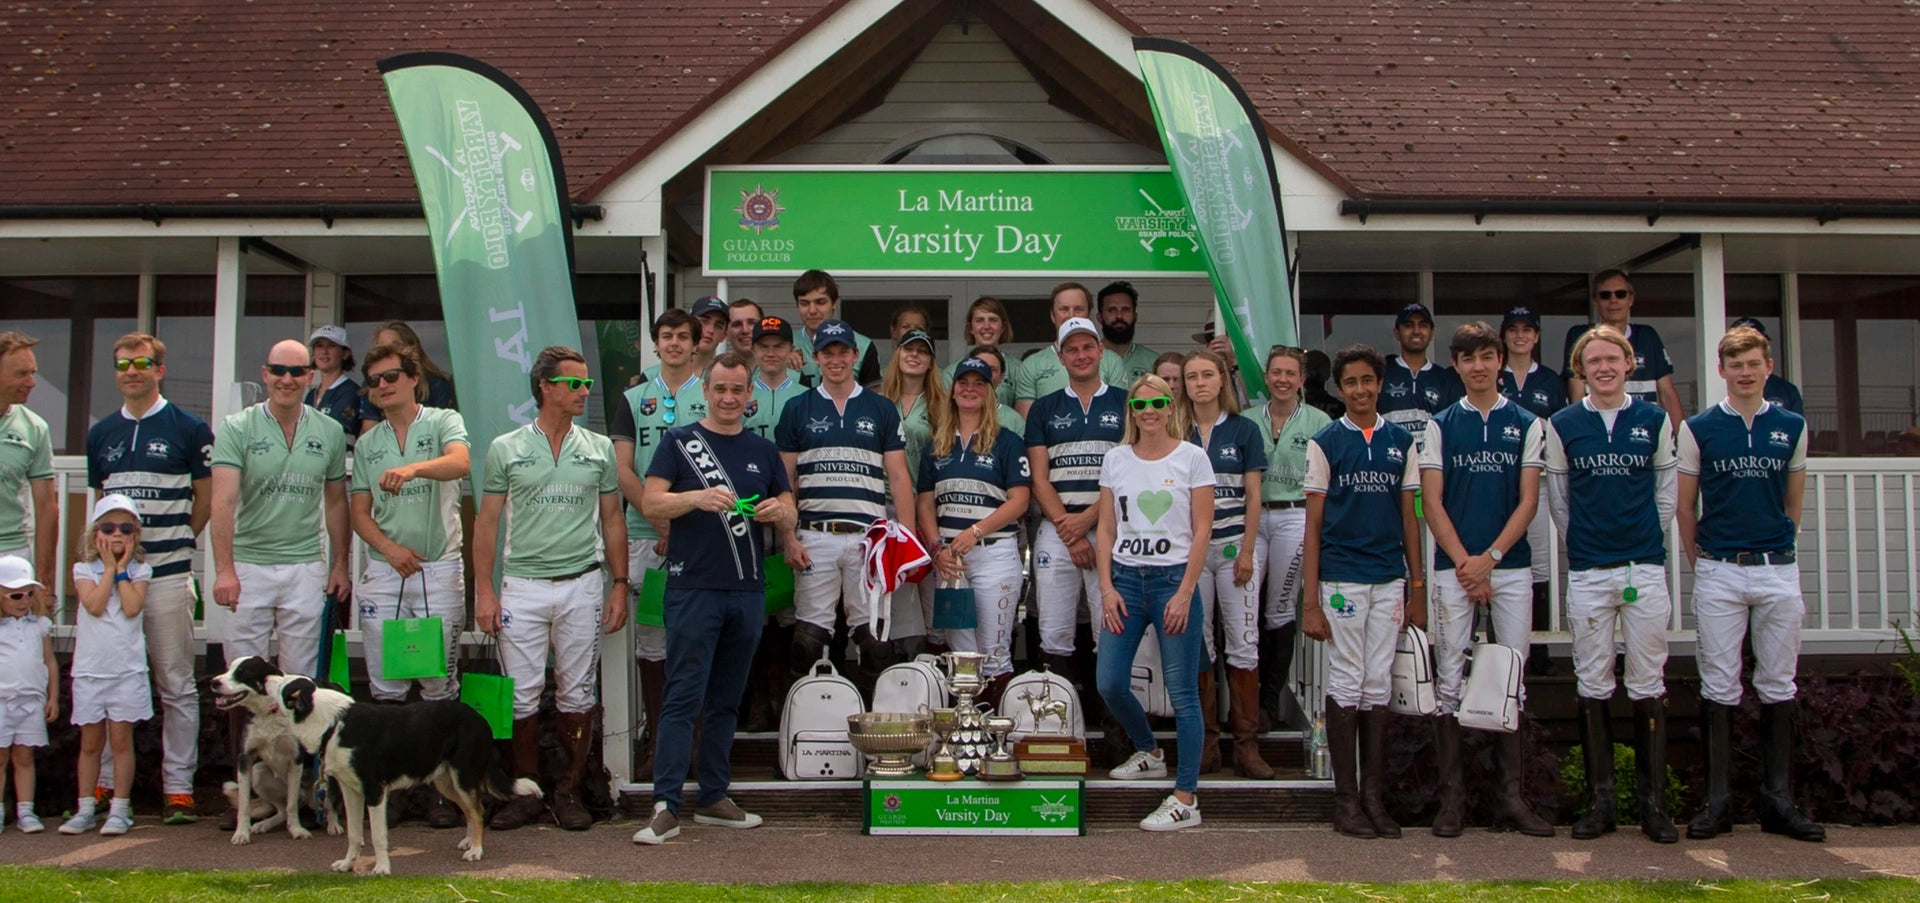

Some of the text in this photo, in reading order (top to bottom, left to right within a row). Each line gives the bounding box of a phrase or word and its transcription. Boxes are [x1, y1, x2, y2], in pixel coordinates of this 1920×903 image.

[898, 189, 1034, 212] La Martina
[1115, 216, 1186, 231] VARSITY
[723, 239, 795, 251] GUARDS
[870, 224, 1062, 262] Varsity Day
[727, 253, 791, 263] POLO CLUB
[639, 425, 669, 447] ET
[201, 444, 214, 467] 3
[1055, 454, 1104, 467] UNIVERSI
[1453, 451, 1519, 468] HARROW
[1574, 453, 1649, 470] HARROW
[1713, 455, 1786, 473] HARROW
[814, 461, 871, 474] UNIVERSITY
[1018, 456, 1031, 478] 3
[1591, 467, 1631, 476] SCHOOL
[1732, 468, 1769, 478] SCHOOL
[1338, 470, 1400, 487] HARROW
[685, 439, 748, 537] OXFD
[526, 495, 586, 507] UNIVERSITY
[1118, 495, 1129, 522] I
[1118, 538, 1171, 556] POLO
[946, 794, 1000, 805] La Martina
[936, 808, 1011, 825] Varsity Day
